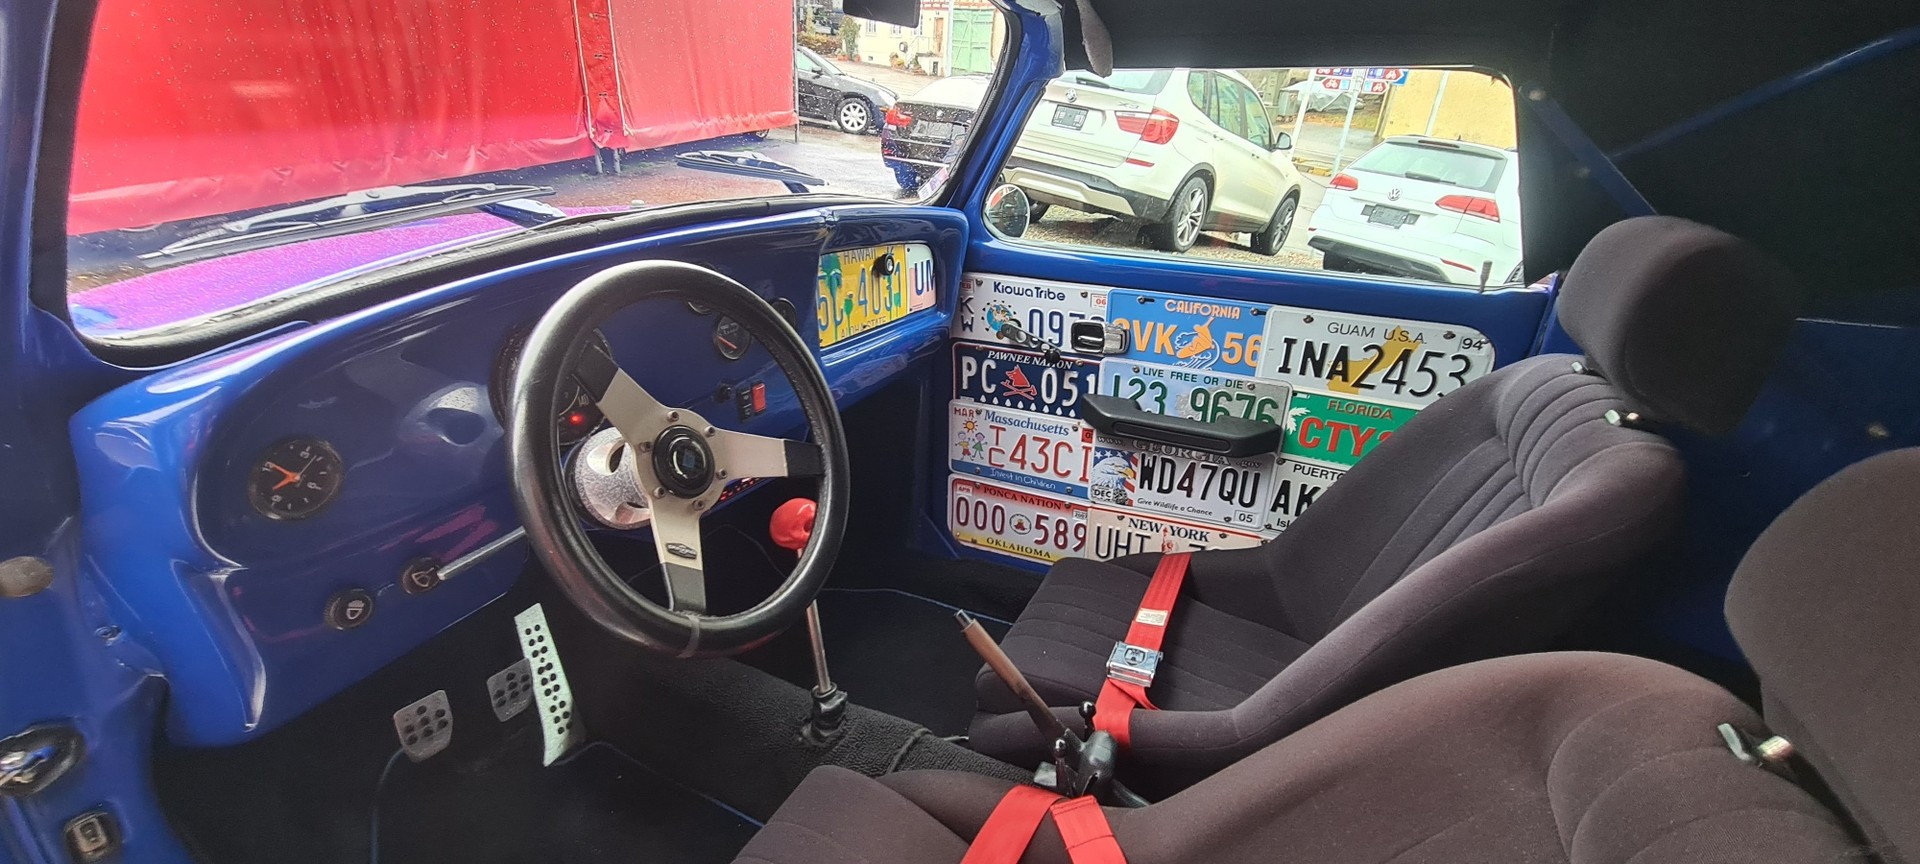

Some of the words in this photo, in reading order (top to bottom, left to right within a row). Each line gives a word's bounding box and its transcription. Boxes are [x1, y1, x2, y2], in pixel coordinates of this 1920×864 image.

[1165, 299, 1241, 320] CALIFORNIA
[1327, 321, 1376, 338] GUAM
[1383, 328, 1428, 345] U.S.A.
[1461, 337, 1484, 350] 94
[987, 350, 1031, 364] PAWNEE
[1032, 355, 1073, 369] NAON
[1277, 337, 1472, 397] INA2453
[961, 355, 997, 394] PC
[1142, 367, 1164, 378] LIVE
[1170, 371, 1198, 383] FREE
[1203, 376, 1219, 386] OR
[1224, 379, 1244, 390] DIE
[953, 406, 975, 419] MAR
[1327, 400, 1393, 420] FLORIDA
[984, 409, 1070, 436] Massachusetts
[1299, 416, 1394, 457] CTY
[1131, 439, 1231, 466] GEORGIA
[989, 467, 1014, 481] Invest
[1023, 475, 1056, 490] Children
[1138, 452, 1261, 508] WD47QU
[983, 487, 1018, 501] PONCA
[1020, 495, 1062, 510] NATION
[1094, 488, 1112, 498] DEC
[1137, 498, 1152, 506] Give
[1153, 499, 1179, 512] Wildlife
[1187, 507, 1213, 517] Chance
[1238, 512, 1254, 523] 05
[1034, 514, 1087, 553] 589
[1128, 517, 1164, 534] NEW
[1168, 525, 1211, 543] YORK
[986, 537, 1051, 559] OKLAHOMA
